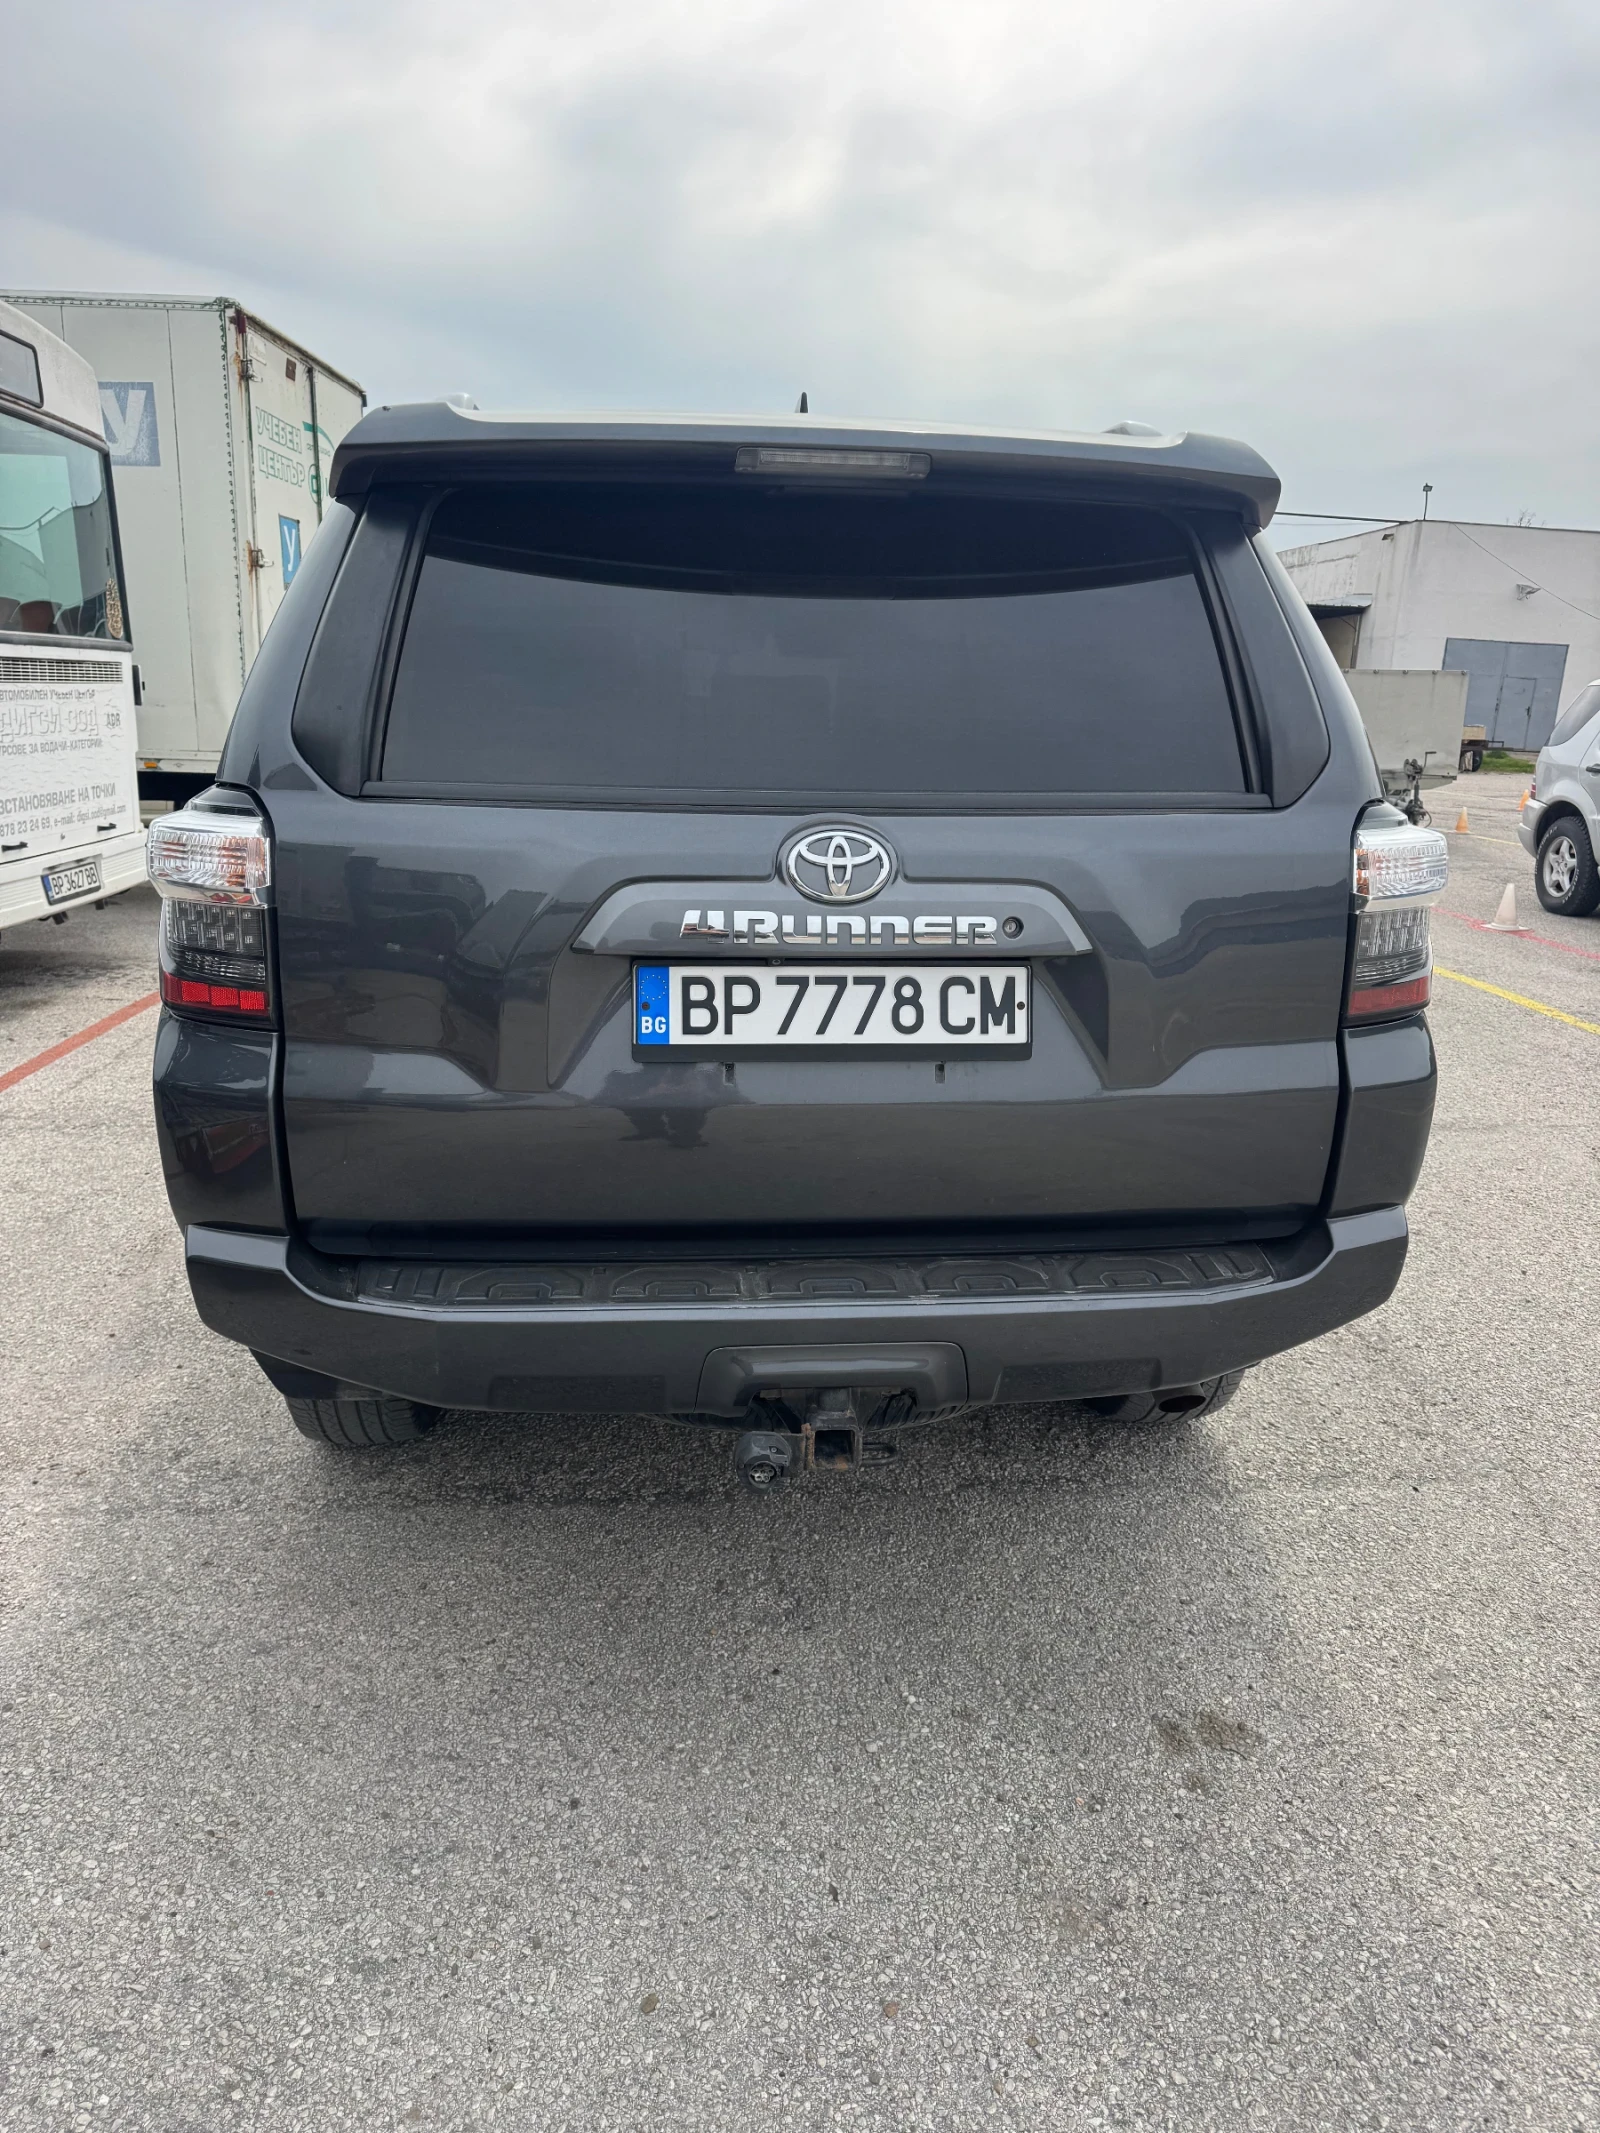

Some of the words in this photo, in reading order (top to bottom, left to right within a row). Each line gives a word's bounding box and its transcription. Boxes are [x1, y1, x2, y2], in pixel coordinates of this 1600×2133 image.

[255, 406, 303, 455] УЧЕБЕН
[258, 444, 306, 489] ЦЕНТЪР
[28, 742, 39, 755] ЗА
[78, 786, 90, 803] НА
[91, 782, 116, 801] ТОЧКИ
[17, 820, 28, 835] 23
[29, 818, 40, 832] 24
[775, 975, 925, 1036] 7778
[641, 1016, 667, 1034] BG
